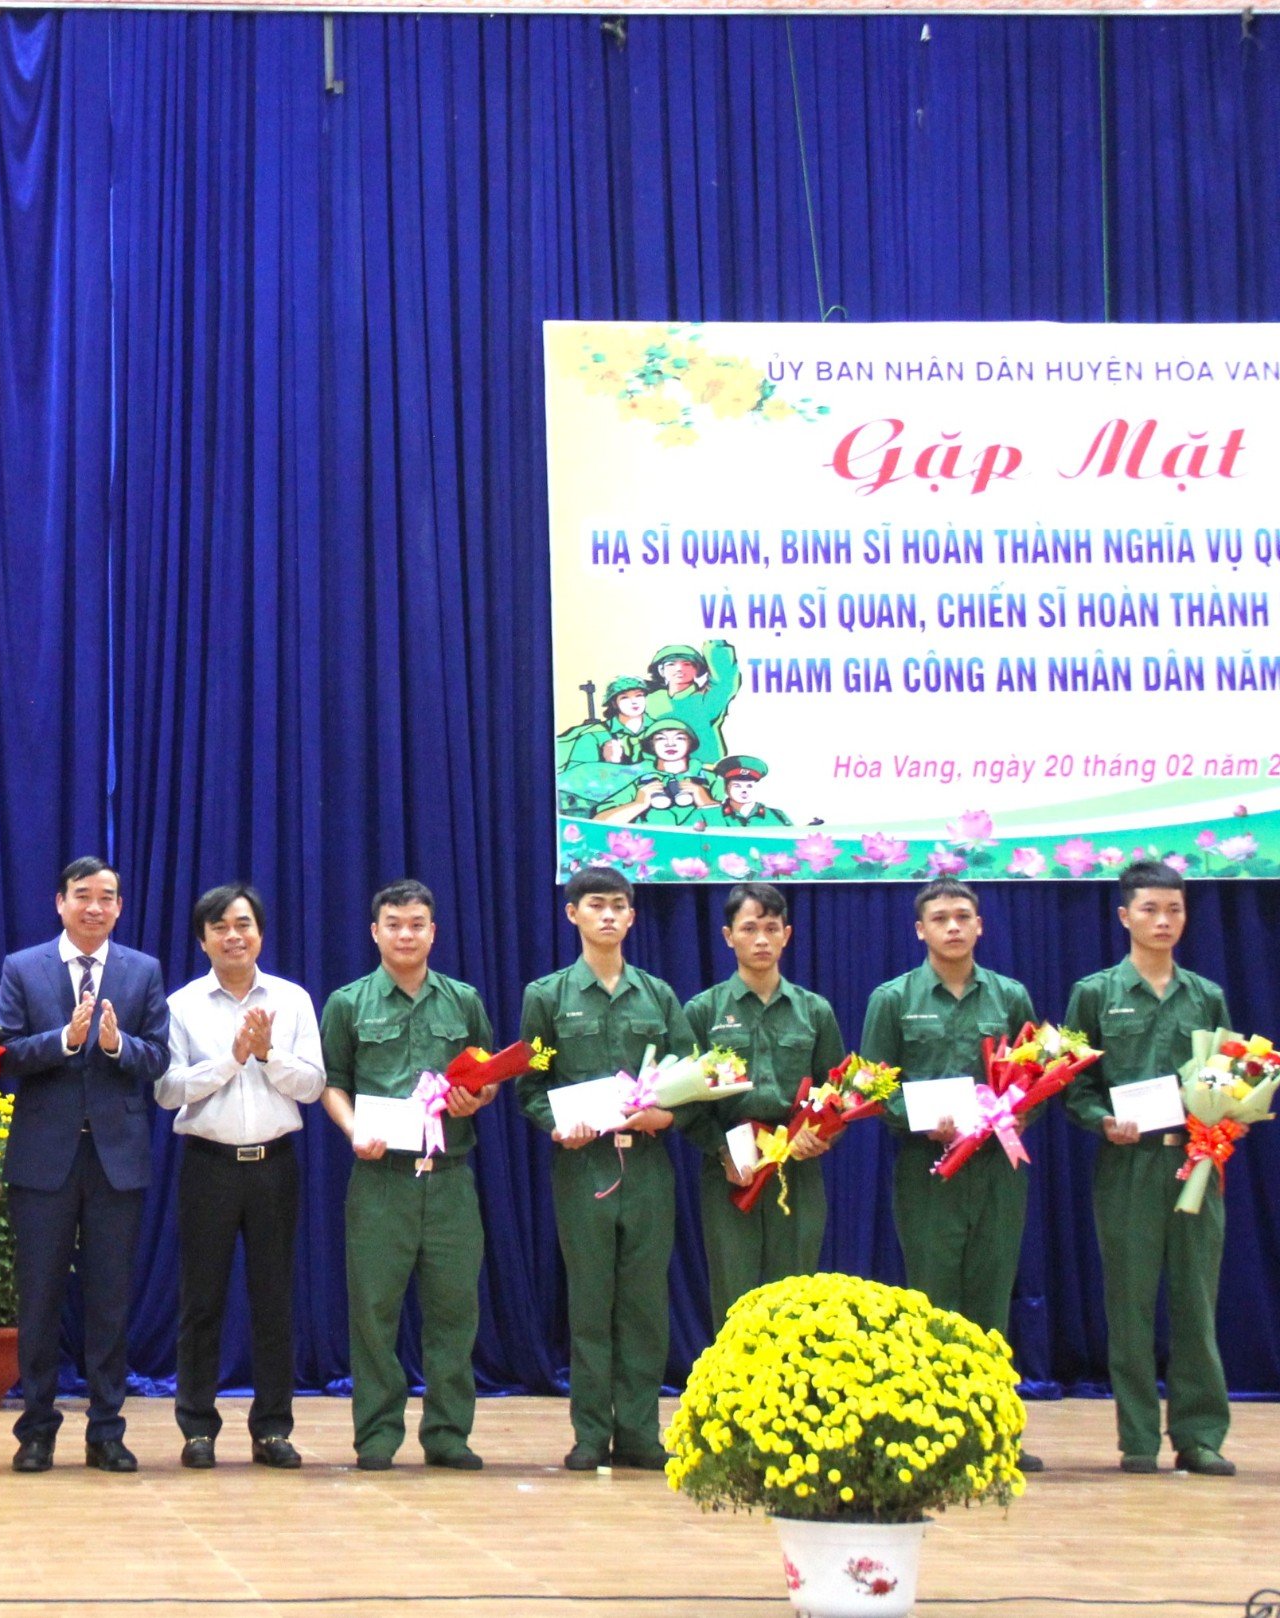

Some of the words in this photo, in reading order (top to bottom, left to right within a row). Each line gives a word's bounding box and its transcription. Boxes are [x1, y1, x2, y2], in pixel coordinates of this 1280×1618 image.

[768, 353, 804, 381] ỦY
[816, 361, 874, 381] BAN
[885, 355, 964, 381] NHÂN
[976, 355, 1034, 381] DÂN
[1046, 356, 1143, 386] HUYỆN
[822, 418, 1032, 497] Gặp
[1057, 418, 1248, 492] Mặt
[592, 529, 631, 573] HẠ
[642, 522, 670, 565] SĨ
[681, 529, 770, 568] QUAN,
[781, 529, 852, 564] BINH
[863, 521, 891, 564] SĨ
[902, 521, 984, 565] HOÀN
[994, 520, 1093, 564] THÀNH
[1104, 521, 1196, 564] NGHĨA
[1206, 528, 1243, 571] VỤ
[700, 586, 738, 629] VÀ
[748, 593, 788, 637] HẠ
[798, 586, 827, 629] SĨ
[838, 593, 927, 632] QUAN,
[937, 581, 1027, 629] CHIẾN
[1038, 585, 1067, 628] SĨ
[1077, 585, 1160, 628] HOÀN
[1170, 584, 1269, 627] THÀNH
[747, 657, 832, 693] THAM
[843, 657, 893, 693] GIA
[903, 649, 986, 693] CÔNG
[996, 657, 1038, 692] AN
[1048, 648, 1132, 692] NHÂN
[1143, 648, 1205, 692] DÂN
[1216, 648, 1280, 691] NĂM
[833, 754, 883, 778] Hòa
[893, 754, 962, 785] Vang,
[972, 754, 1036, 785] ngày
[1044, 754, 1075, 777] 20
[1083, 753, 1157, 783] tháng
[1166, 753, 1194, 777] 02
[1204, 752, 1259, 776] năm
